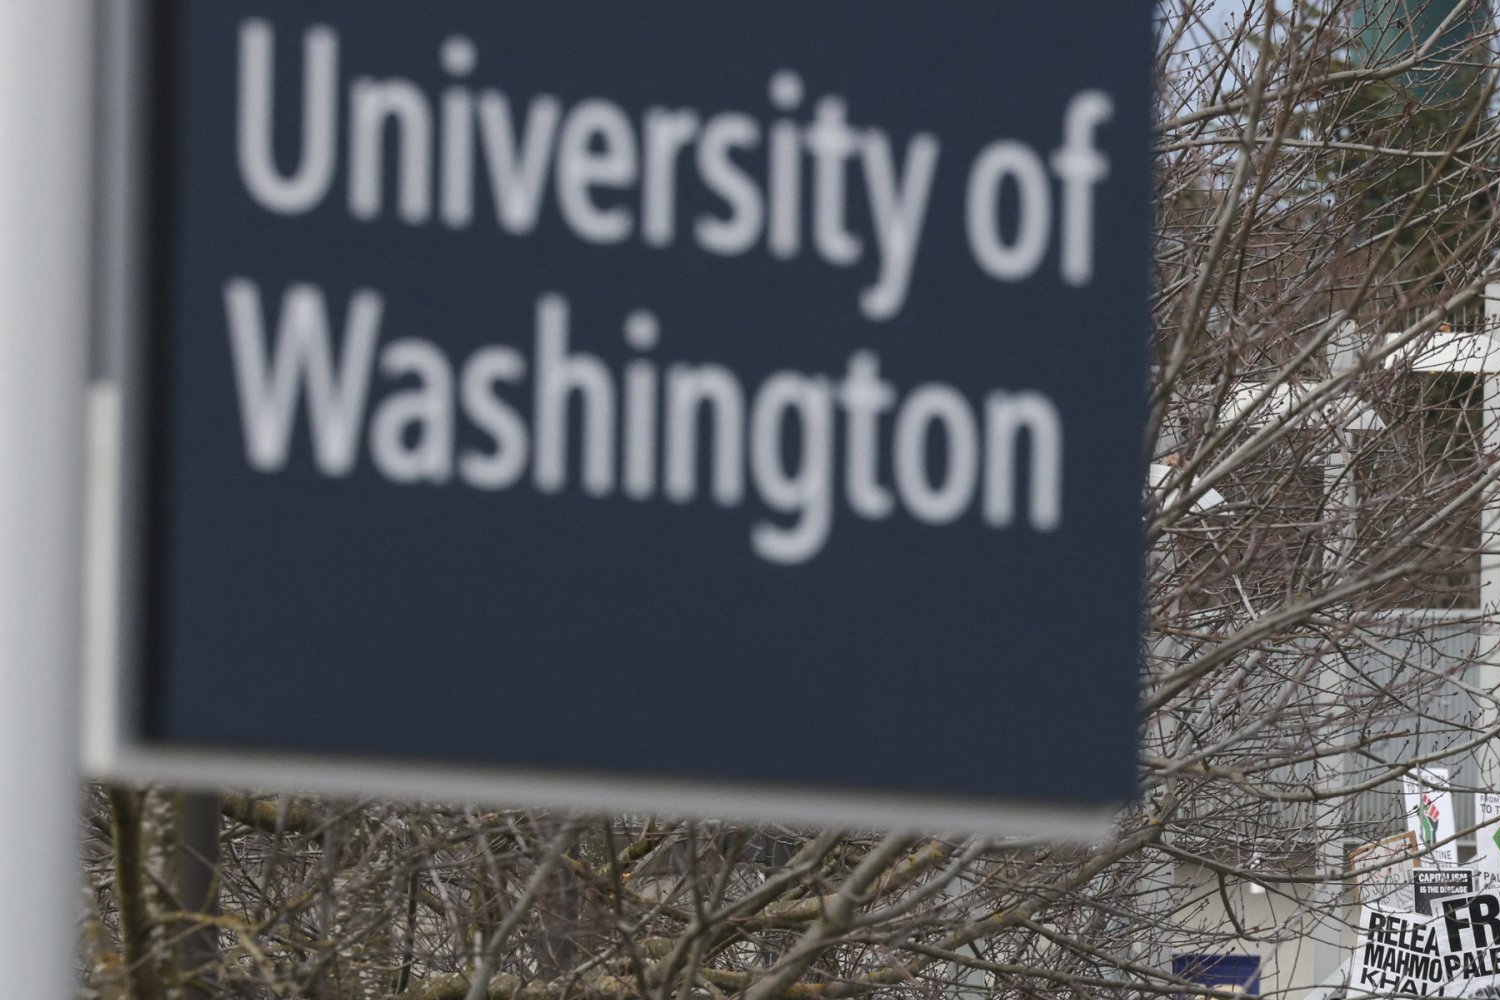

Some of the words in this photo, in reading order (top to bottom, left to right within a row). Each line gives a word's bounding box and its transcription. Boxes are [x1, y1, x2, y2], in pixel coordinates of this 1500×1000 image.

[236, 19, 938, 320] University
[965, 91, 1115, 286] of
[224, 278, 1062, 564] Washington
[1480, 804, 1492, 814] TO
